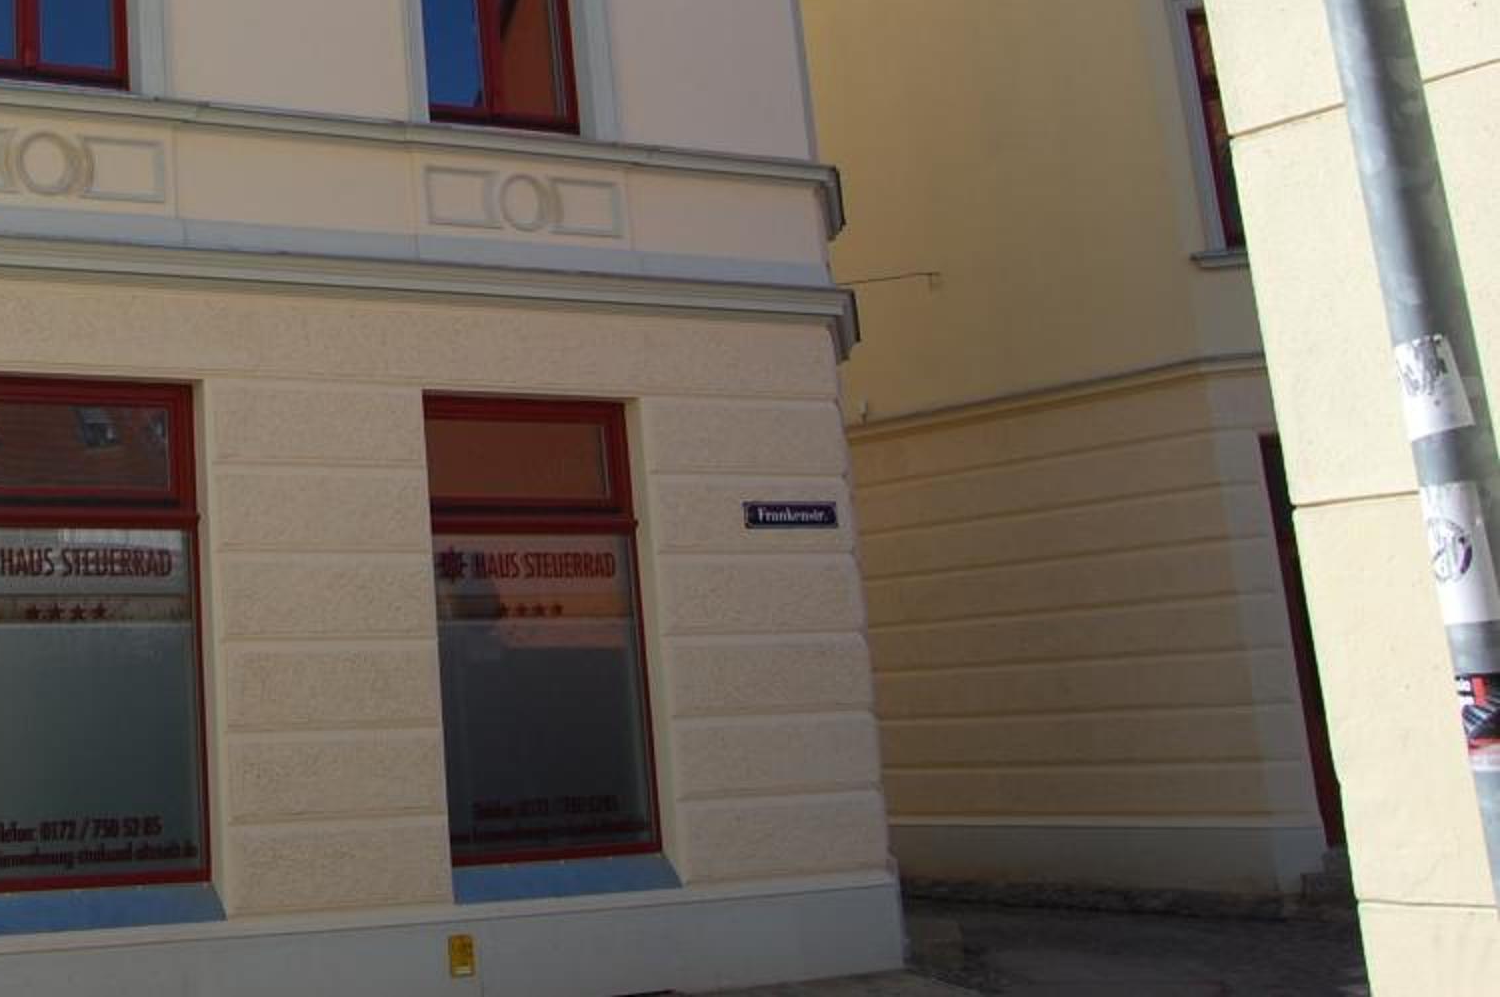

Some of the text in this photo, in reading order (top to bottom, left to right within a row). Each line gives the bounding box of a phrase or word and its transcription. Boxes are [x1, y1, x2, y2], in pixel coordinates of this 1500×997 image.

[0, 547, 173, 577] HAUS STEUERRAD
[474, 551, 616, 578] HAUS STEUERRAD
